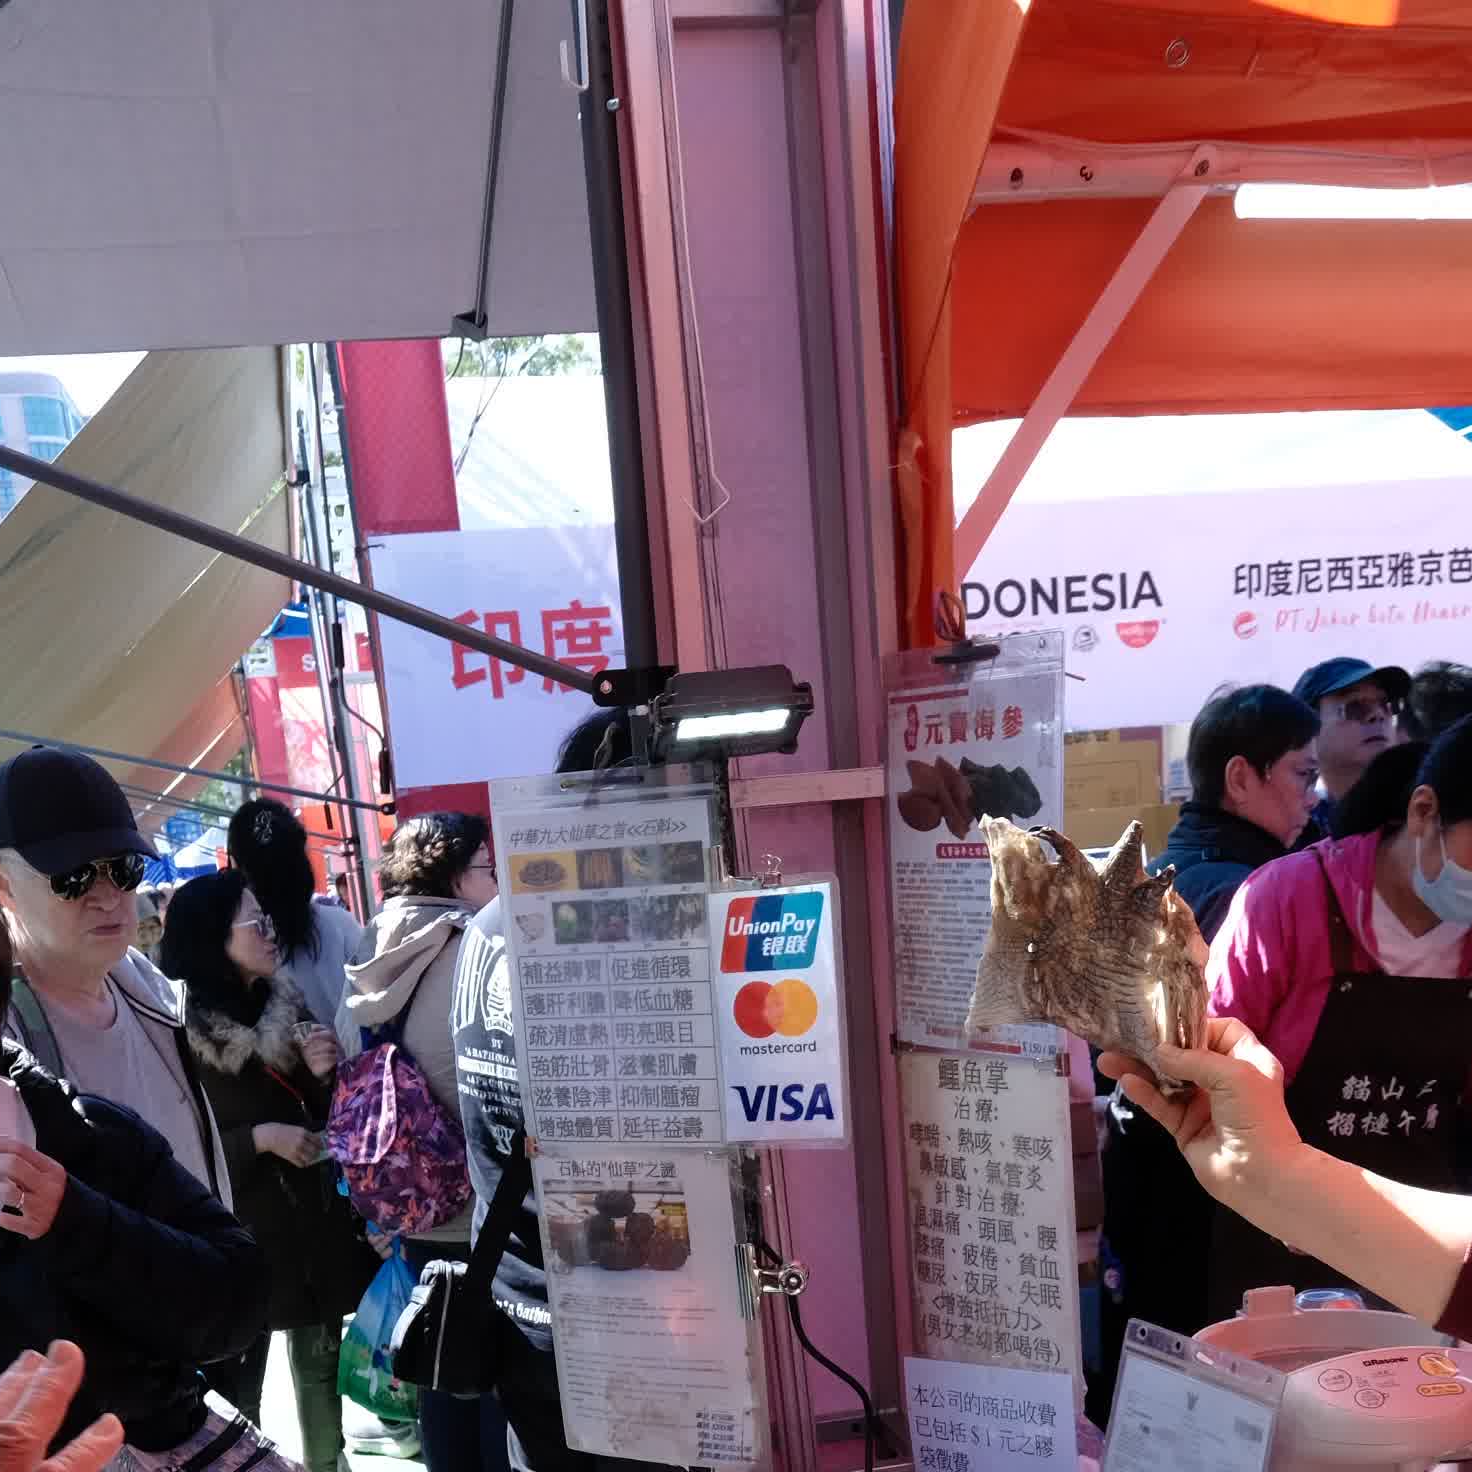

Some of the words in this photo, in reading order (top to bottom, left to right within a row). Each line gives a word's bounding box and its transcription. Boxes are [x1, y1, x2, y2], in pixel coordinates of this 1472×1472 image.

[728, 908, 816, 942] UnionPay
[761, 936, 808, 957] 银联
[739, 1040, 818, 1056] mastercard
[938, 1057, 1009, 1096] 鱷魚掌
[731, 1083, 836, 1123] VISA
[623, 1115, 703, 1139] 延年益壽
